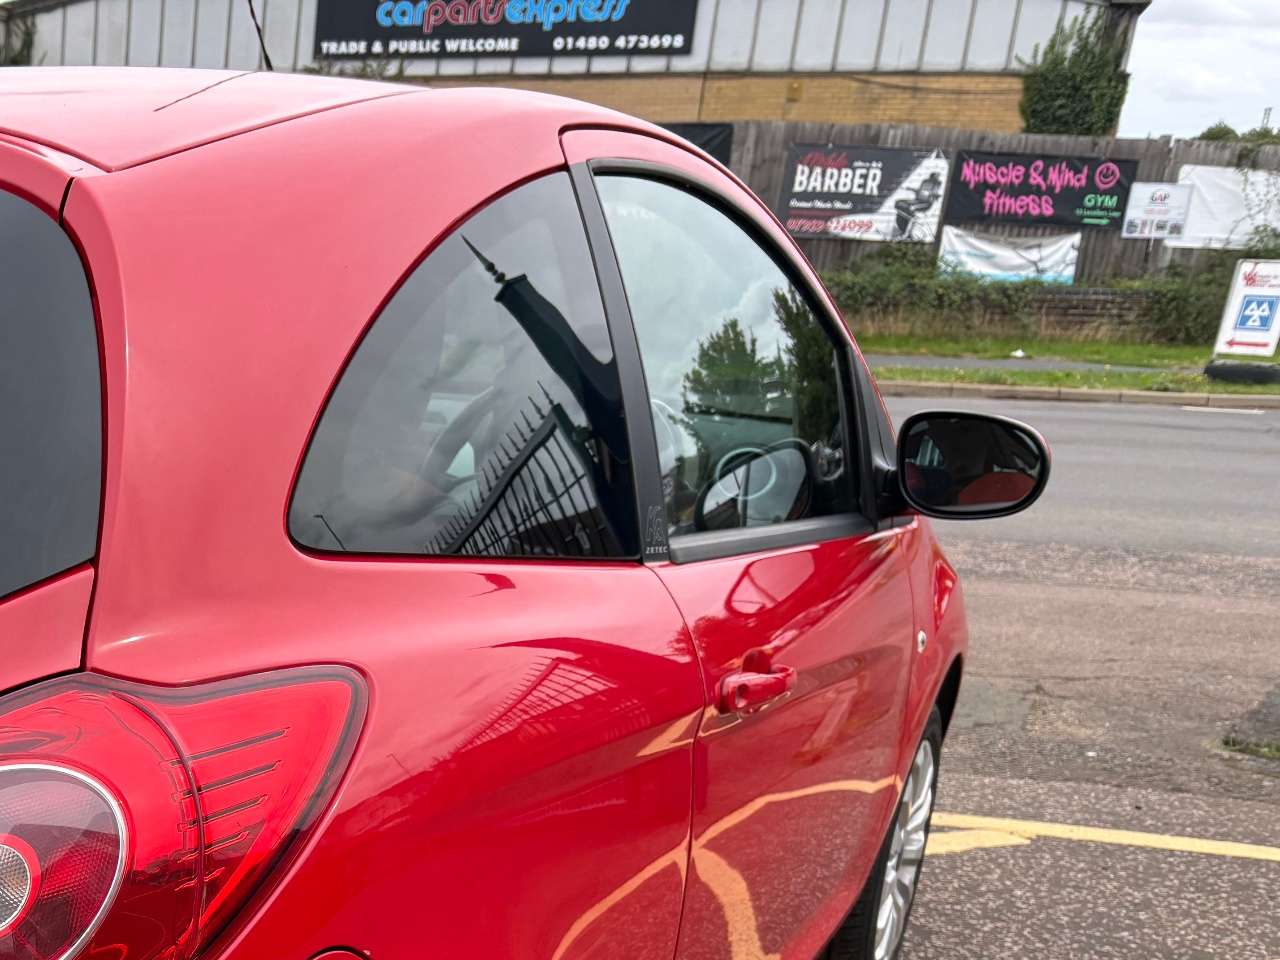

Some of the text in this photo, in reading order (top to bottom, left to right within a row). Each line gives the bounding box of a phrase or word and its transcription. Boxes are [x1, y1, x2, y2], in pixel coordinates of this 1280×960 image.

[321, 33, 685, 55] TRADE & PUBLIC WELCOME 01480 473698
[792, 163, 883, 197] BARBER
[1028, 159, 1048, 192] &
[1083, 193, 1119, 207] GYM
[645, 546, 668, 554] ZETEC
